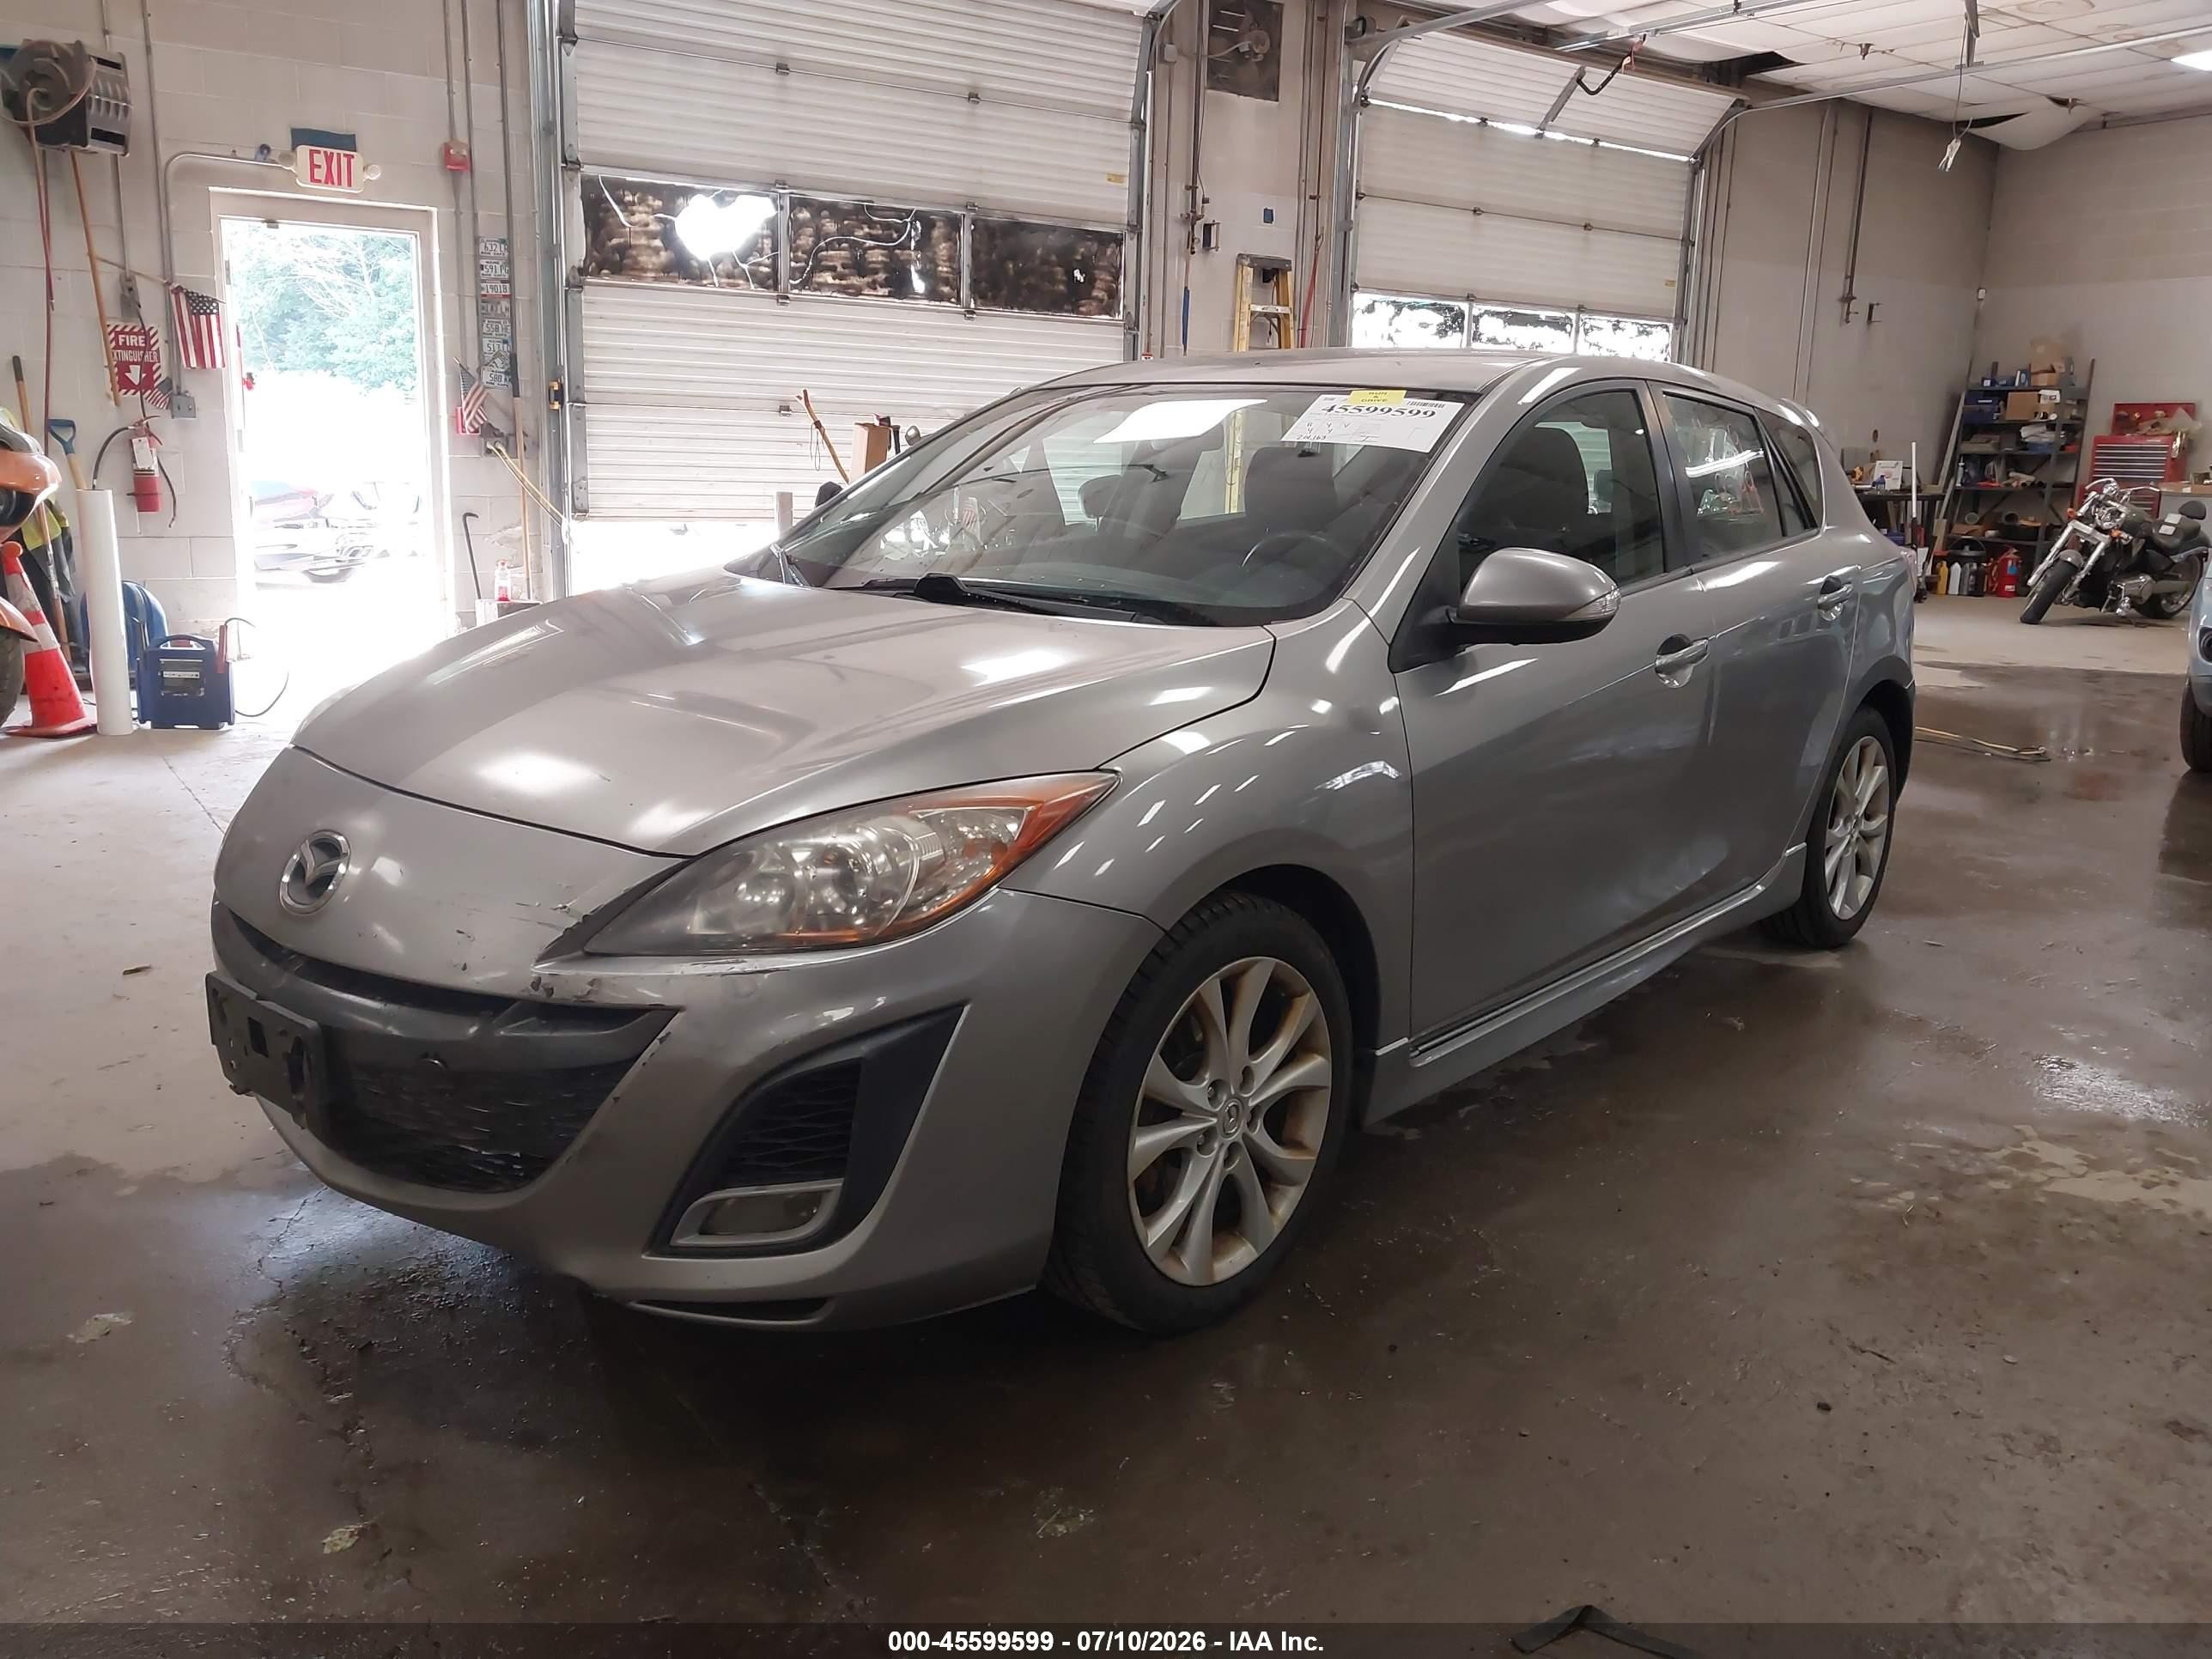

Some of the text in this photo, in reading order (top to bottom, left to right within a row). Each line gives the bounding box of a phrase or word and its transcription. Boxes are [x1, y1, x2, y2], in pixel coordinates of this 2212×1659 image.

[308, 149, 355, 187] EXIT
[118, 334, 146, 347] FIRE
[111, 349, 160, 362] XTINGUISHER
[1322, 404, 1436, 419] 45599599
